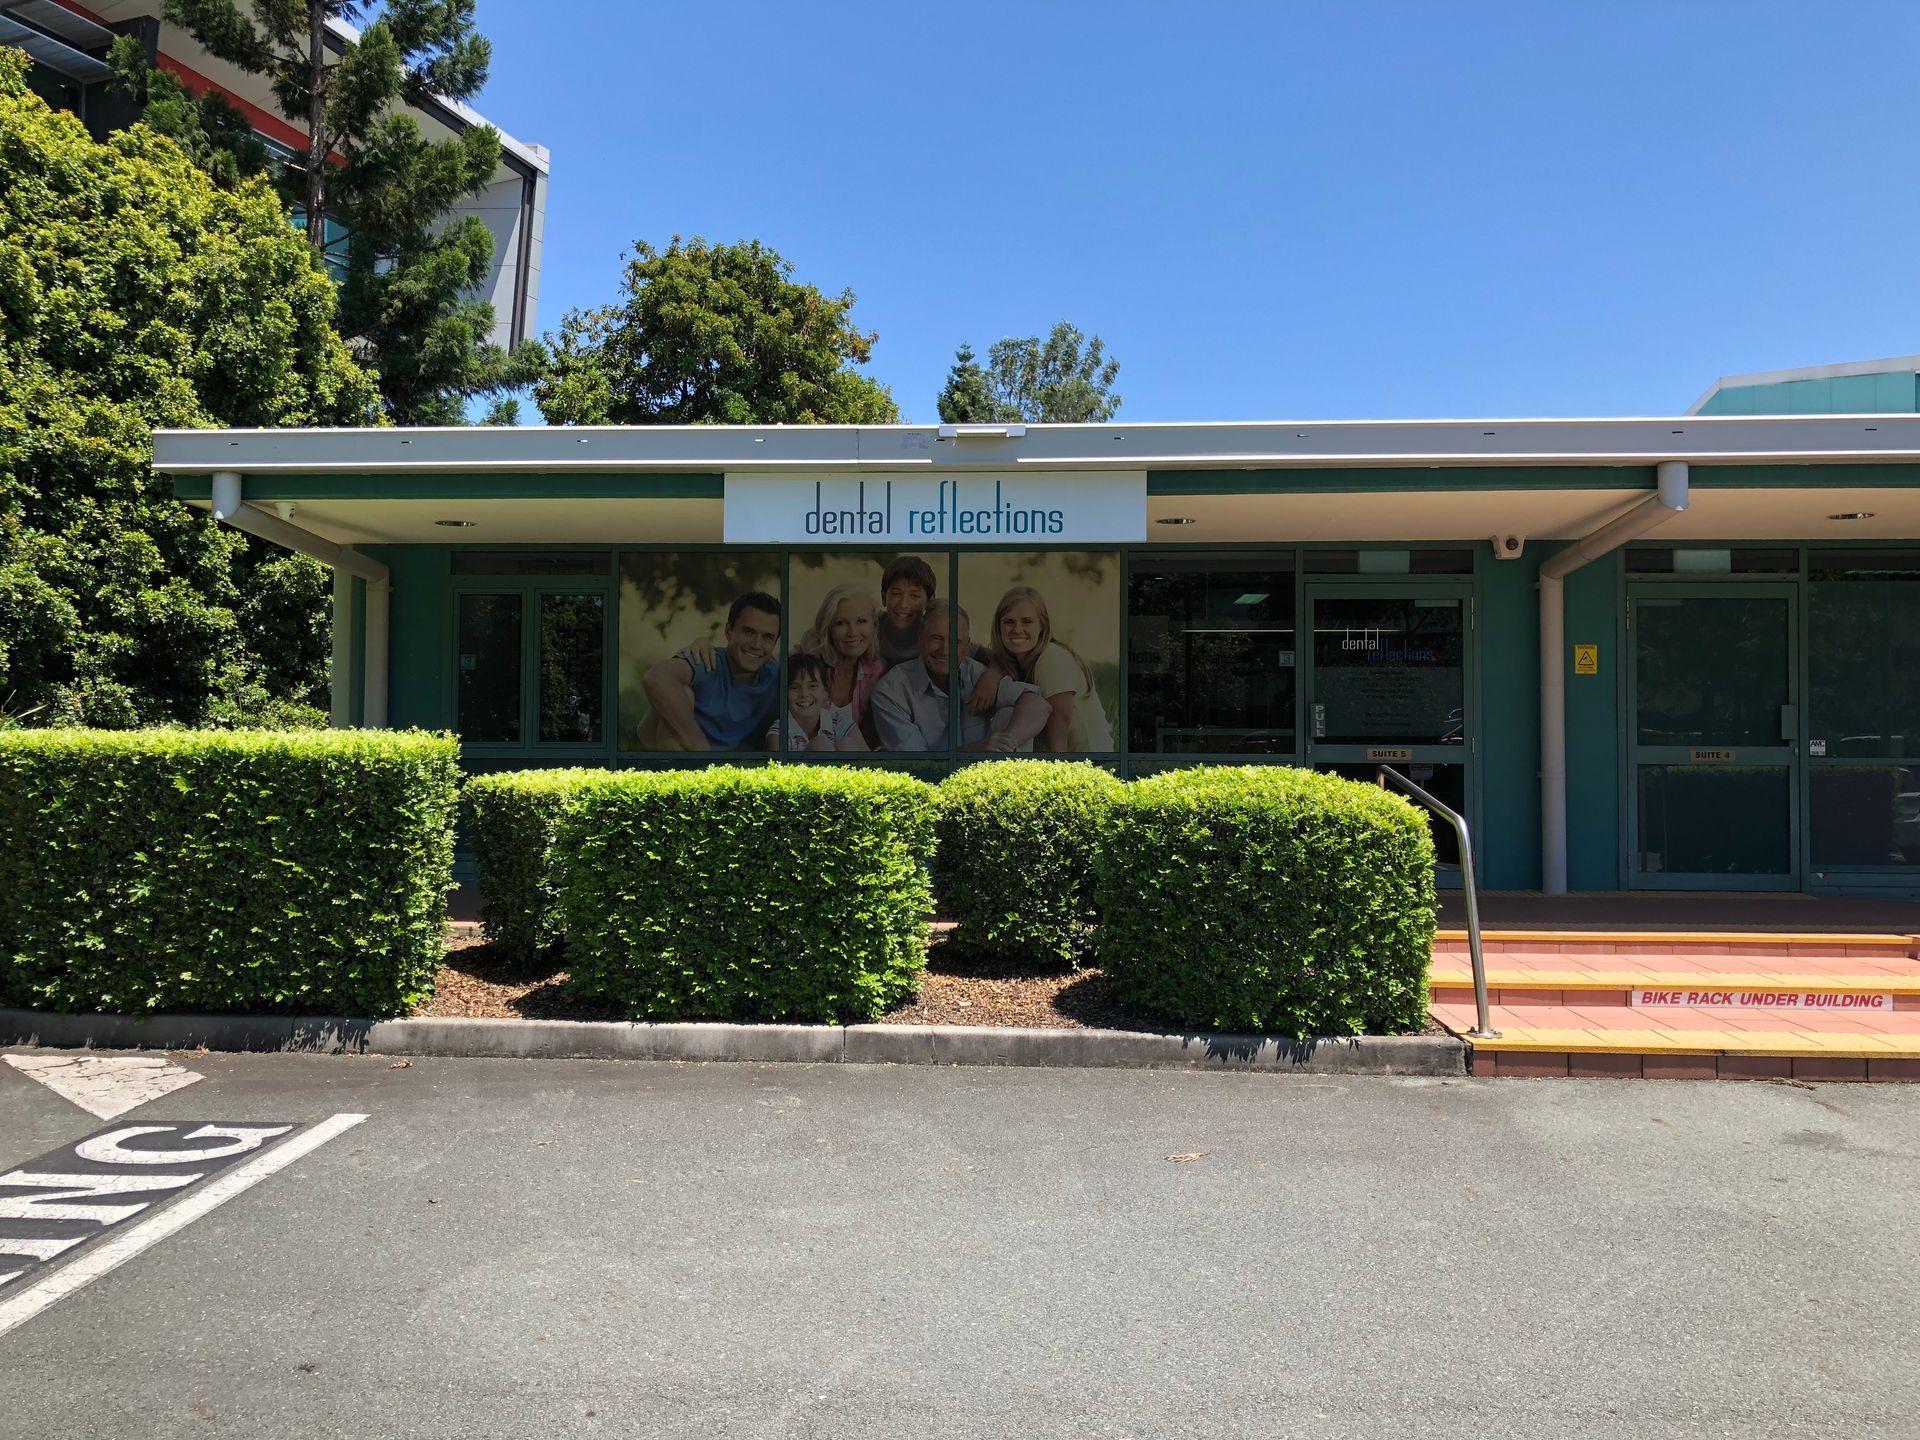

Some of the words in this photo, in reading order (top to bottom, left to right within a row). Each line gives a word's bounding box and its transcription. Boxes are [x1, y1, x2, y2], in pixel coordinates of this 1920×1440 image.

[805, 481, 891, 534] dental
[909, 480, 1064, 534] reflections
[1342, 628, 1379, 650] dental
[1367, 639, 1433, 661] reflections
[1315, 705, 1325, 737] PULL
[1372, 750, 1398, 758] SUITE
[1400, 750, 1407, 758] 5
[1695, 751, 1721, 759] SUITE
[1724, 751, 1730, 759] 4
[1641, 991, 1682, 1004] BIKE
[1687, 991, 1735, 1005] RACK
[1740, 992, 1799, 1006] UNDER
[1804, 994, 1883, 1008] BUILDING
